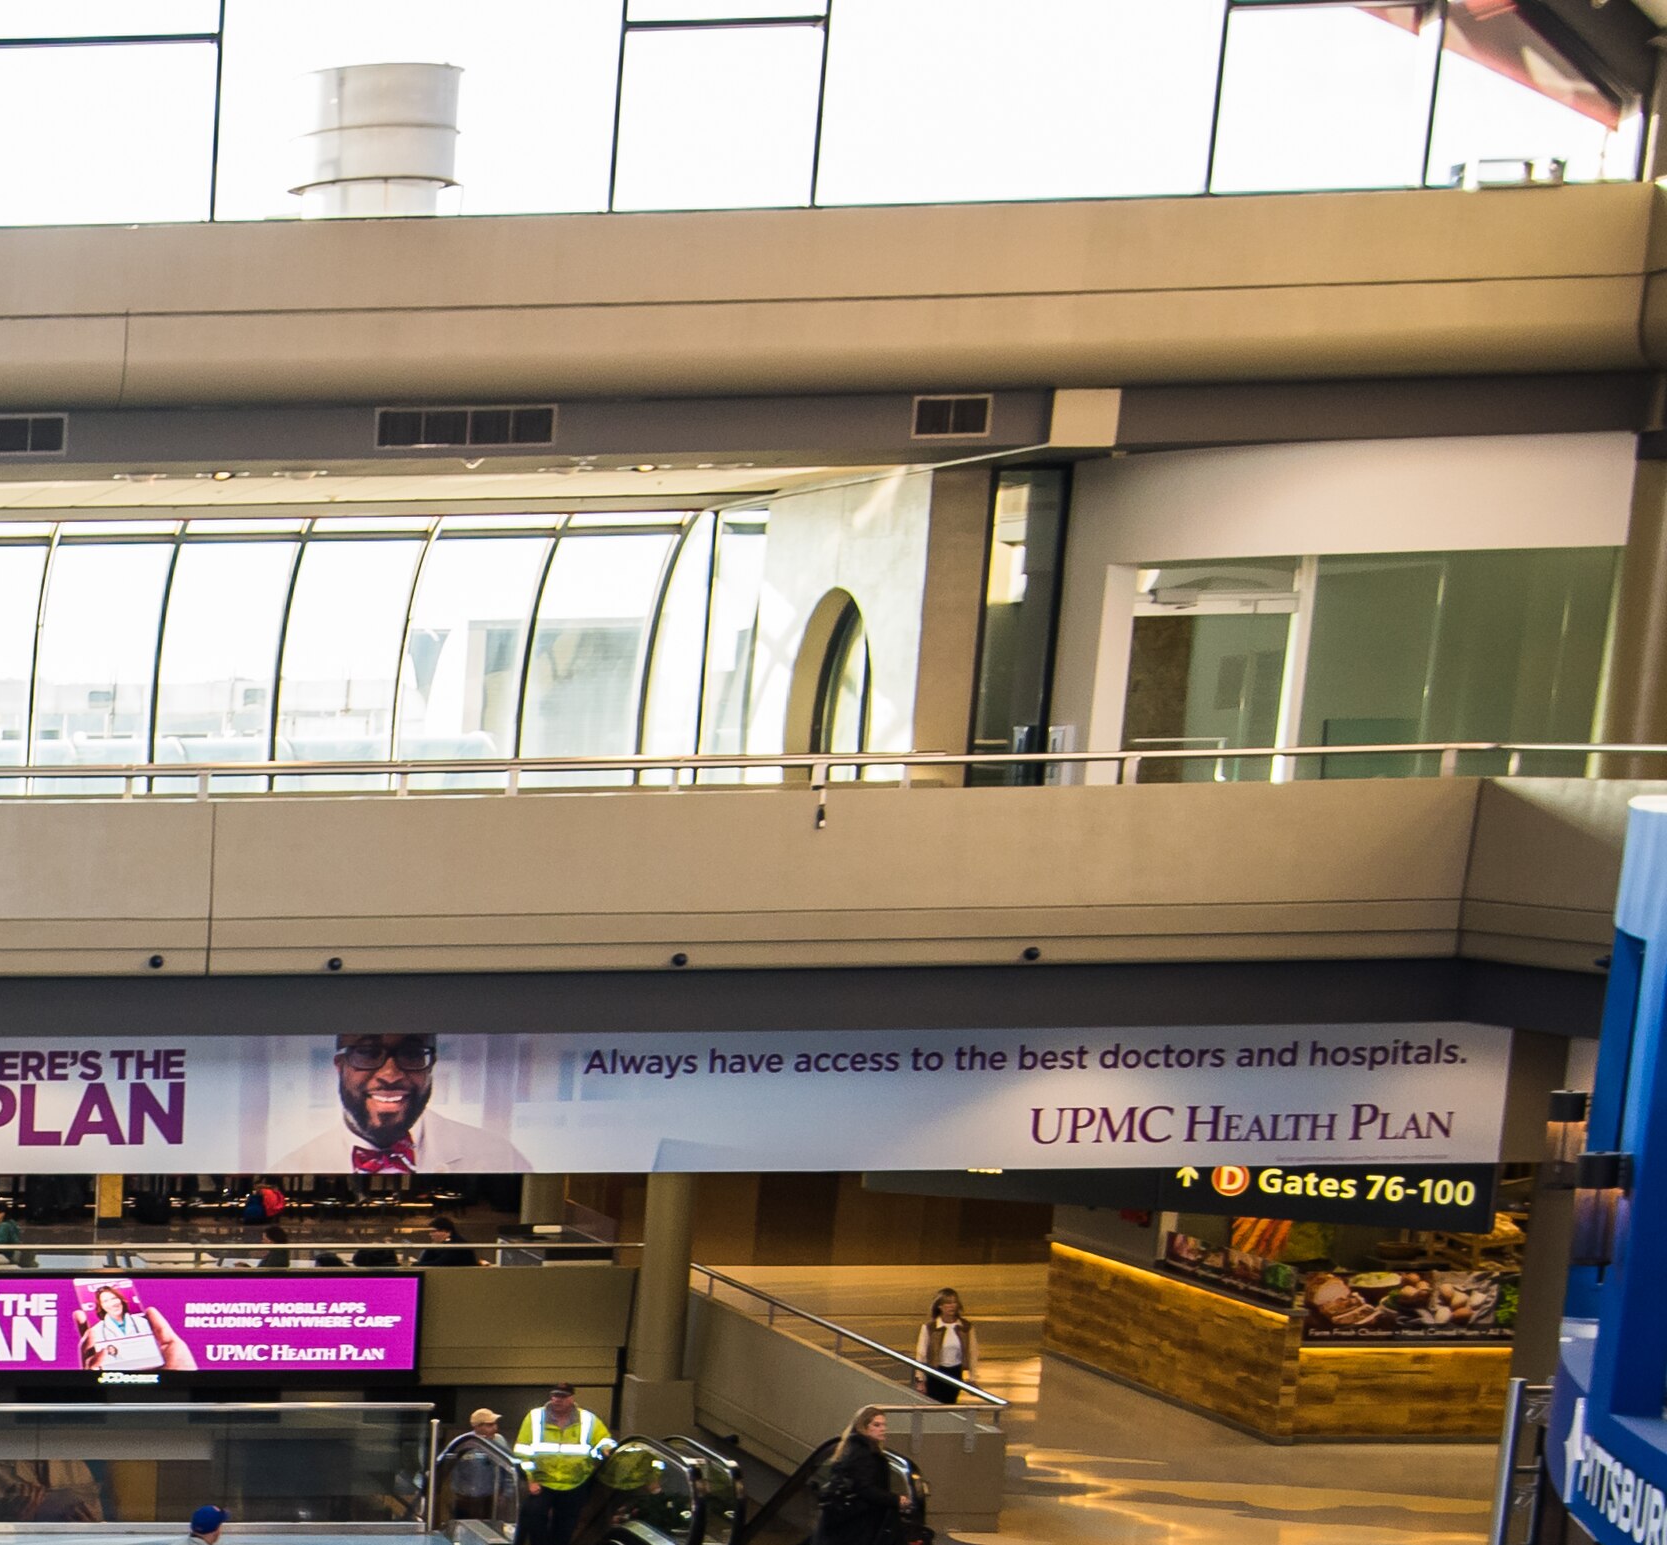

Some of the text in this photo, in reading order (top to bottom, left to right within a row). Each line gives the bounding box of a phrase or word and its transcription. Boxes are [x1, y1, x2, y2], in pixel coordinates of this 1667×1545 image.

[110, 1049, 186, 1080] THE
[584, 1038, 1467, 1078] Always have access to the best doctors and hospitals.
[1030, 1103, 1455, 1145] UPMC HEALTH PLAN
[1219, 1165, 1476, 1207] D Gates 76-100
[184, 1316, 263, 1328] INCLUDING
[185, 1302, 367, 1315] INNOVATIVE MOBILE APPS
[206, 1344, 385, 1361] UPMC HEALTH PLAN
